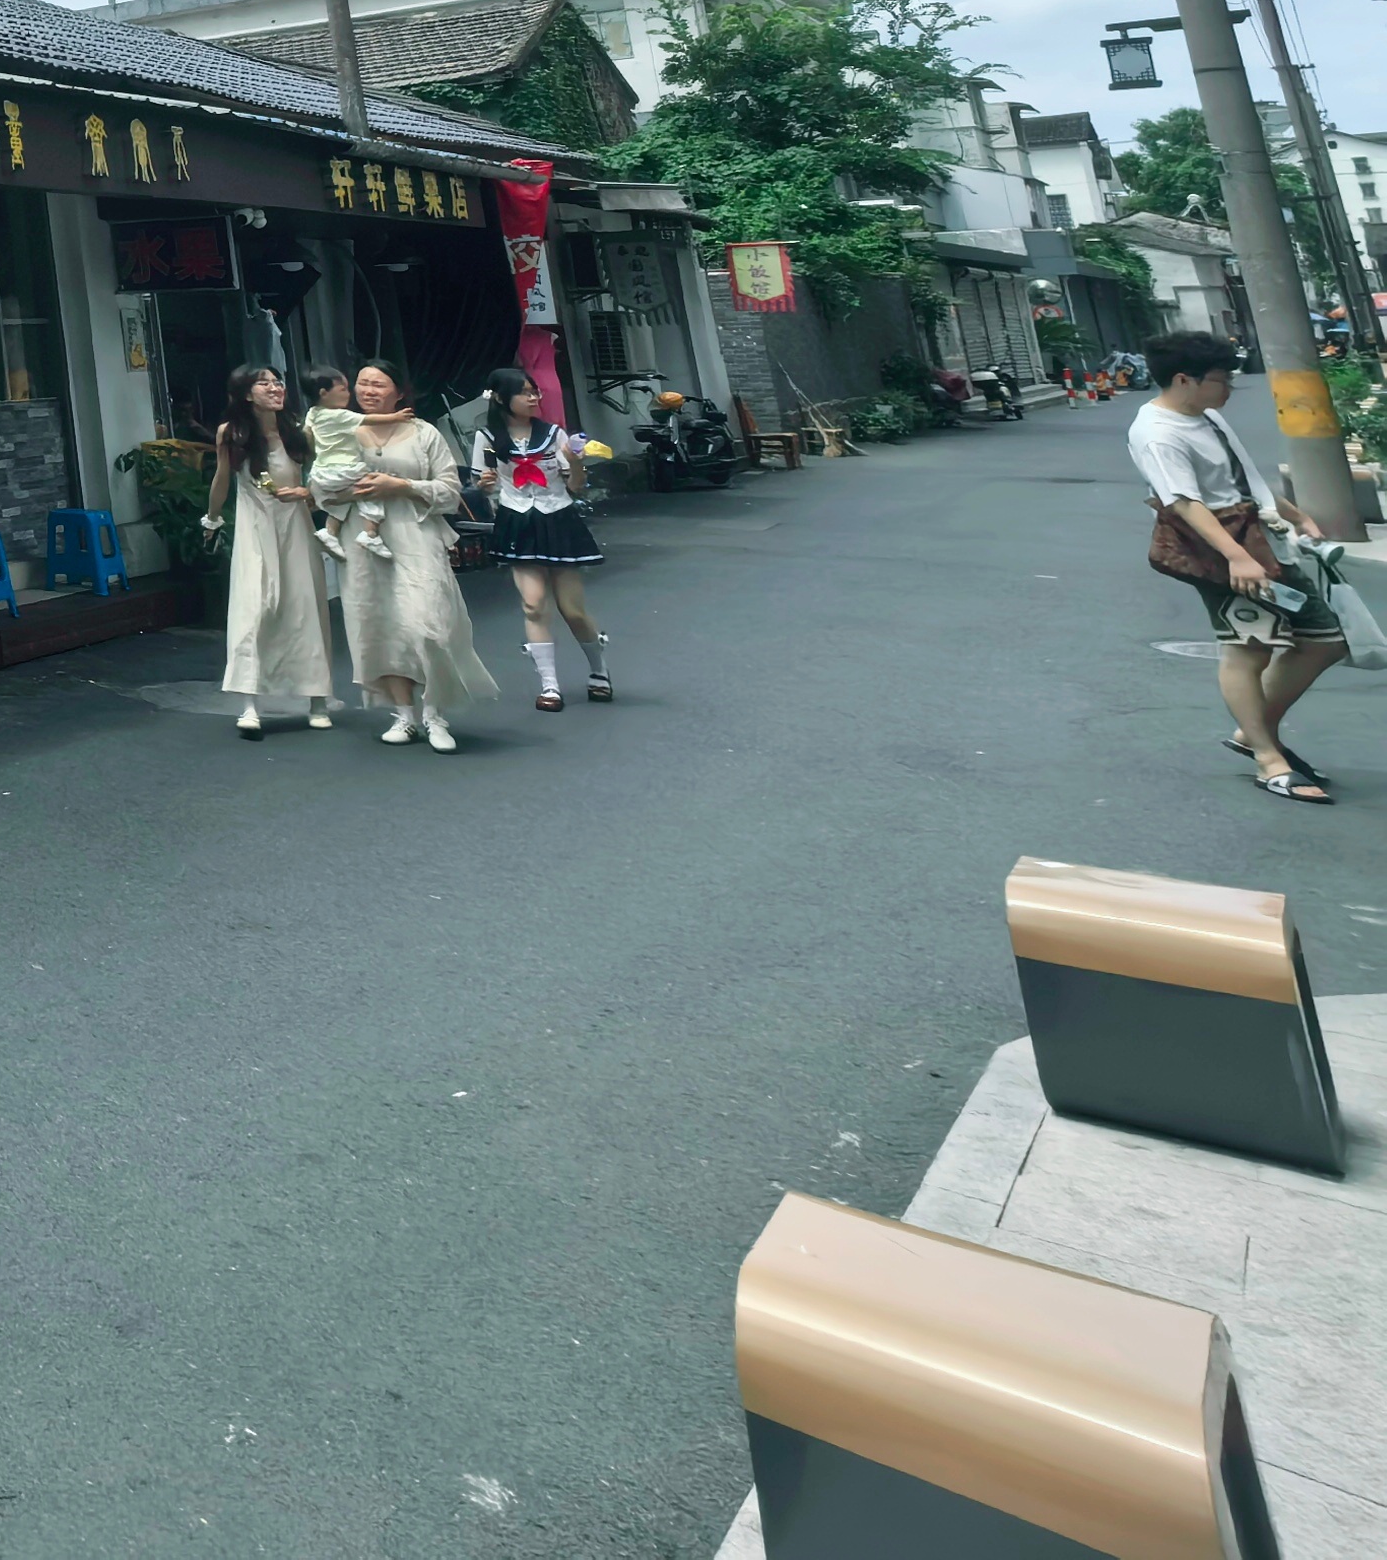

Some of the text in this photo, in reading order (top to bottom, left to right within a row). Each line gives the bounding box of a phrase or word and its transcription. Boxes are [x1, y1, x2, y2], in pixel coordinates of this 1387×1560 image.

[330, 158, 469, 220] 轩轩鲜果店
[117, 228, 227, 285] 水果
